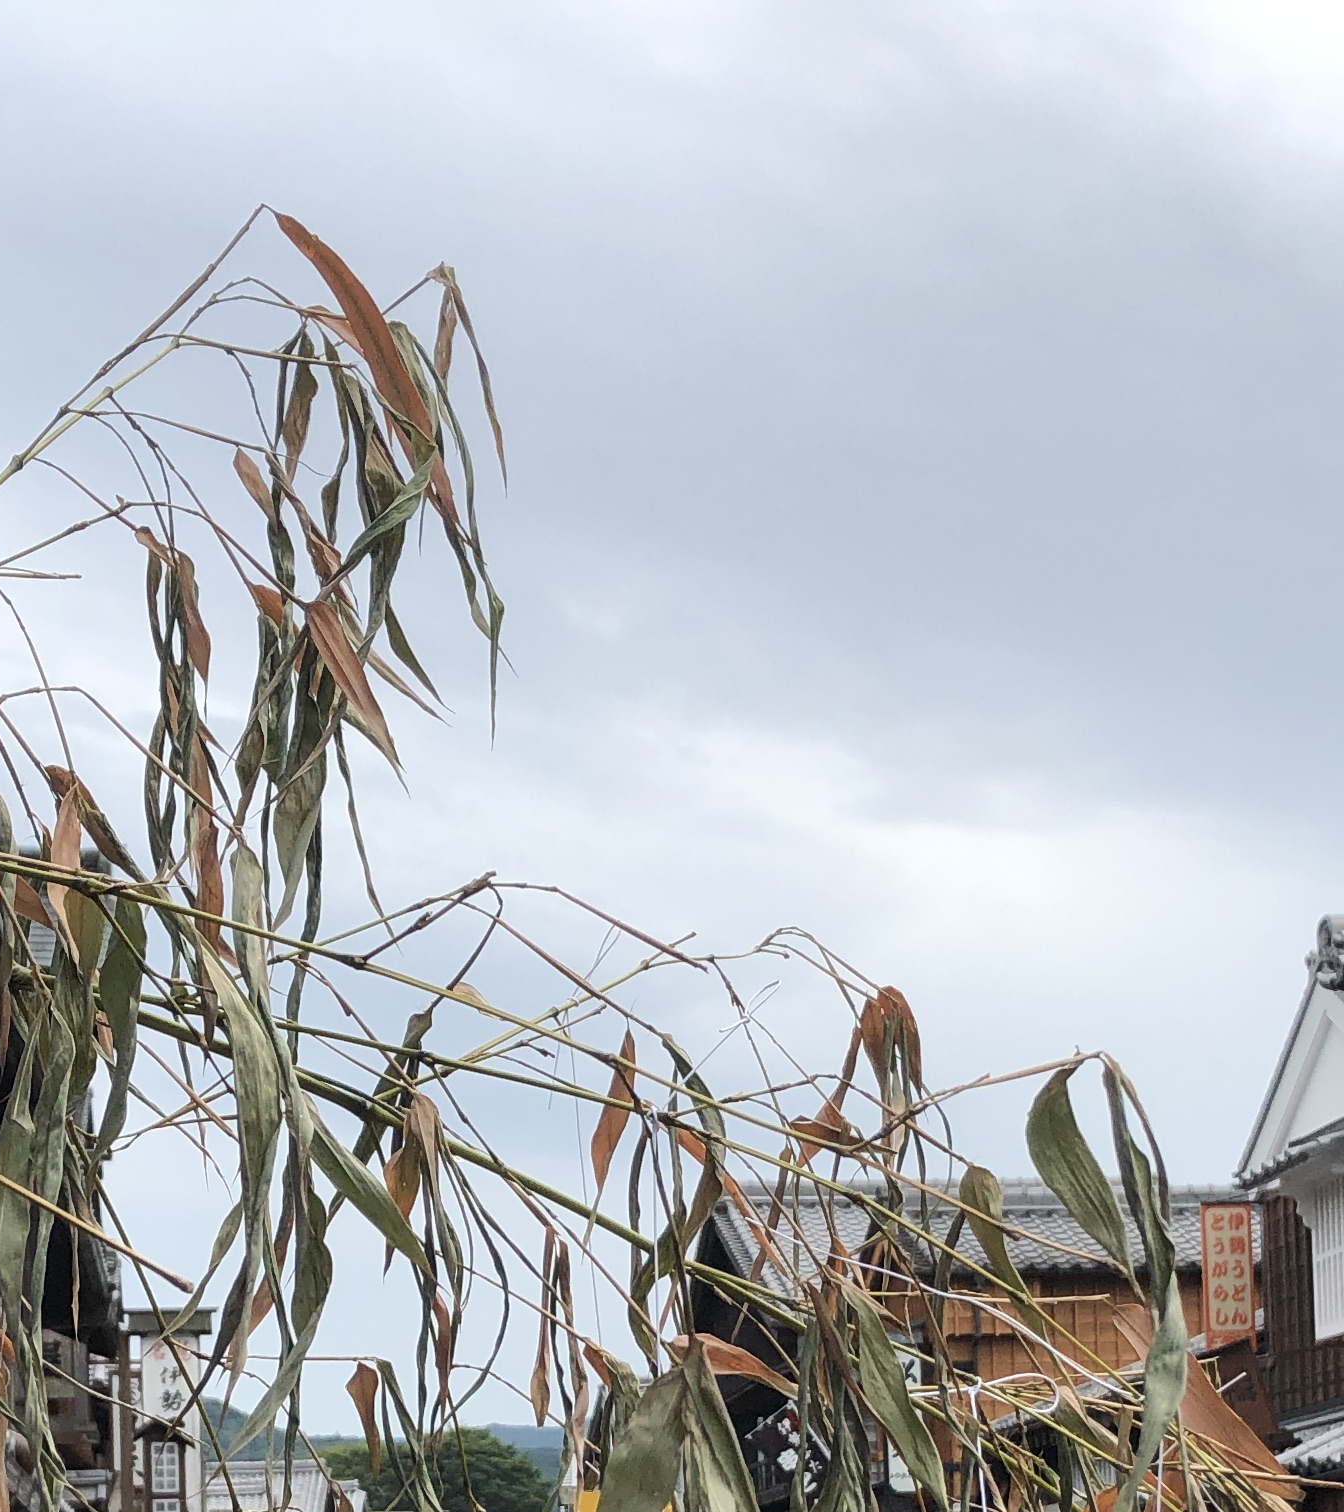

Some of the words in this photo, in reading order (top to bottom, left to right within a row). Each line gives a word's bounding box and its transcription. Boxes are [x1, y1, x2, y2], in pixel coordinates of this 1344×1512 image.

[1228, 1212, 1248, 1326] 伊勢うどん
